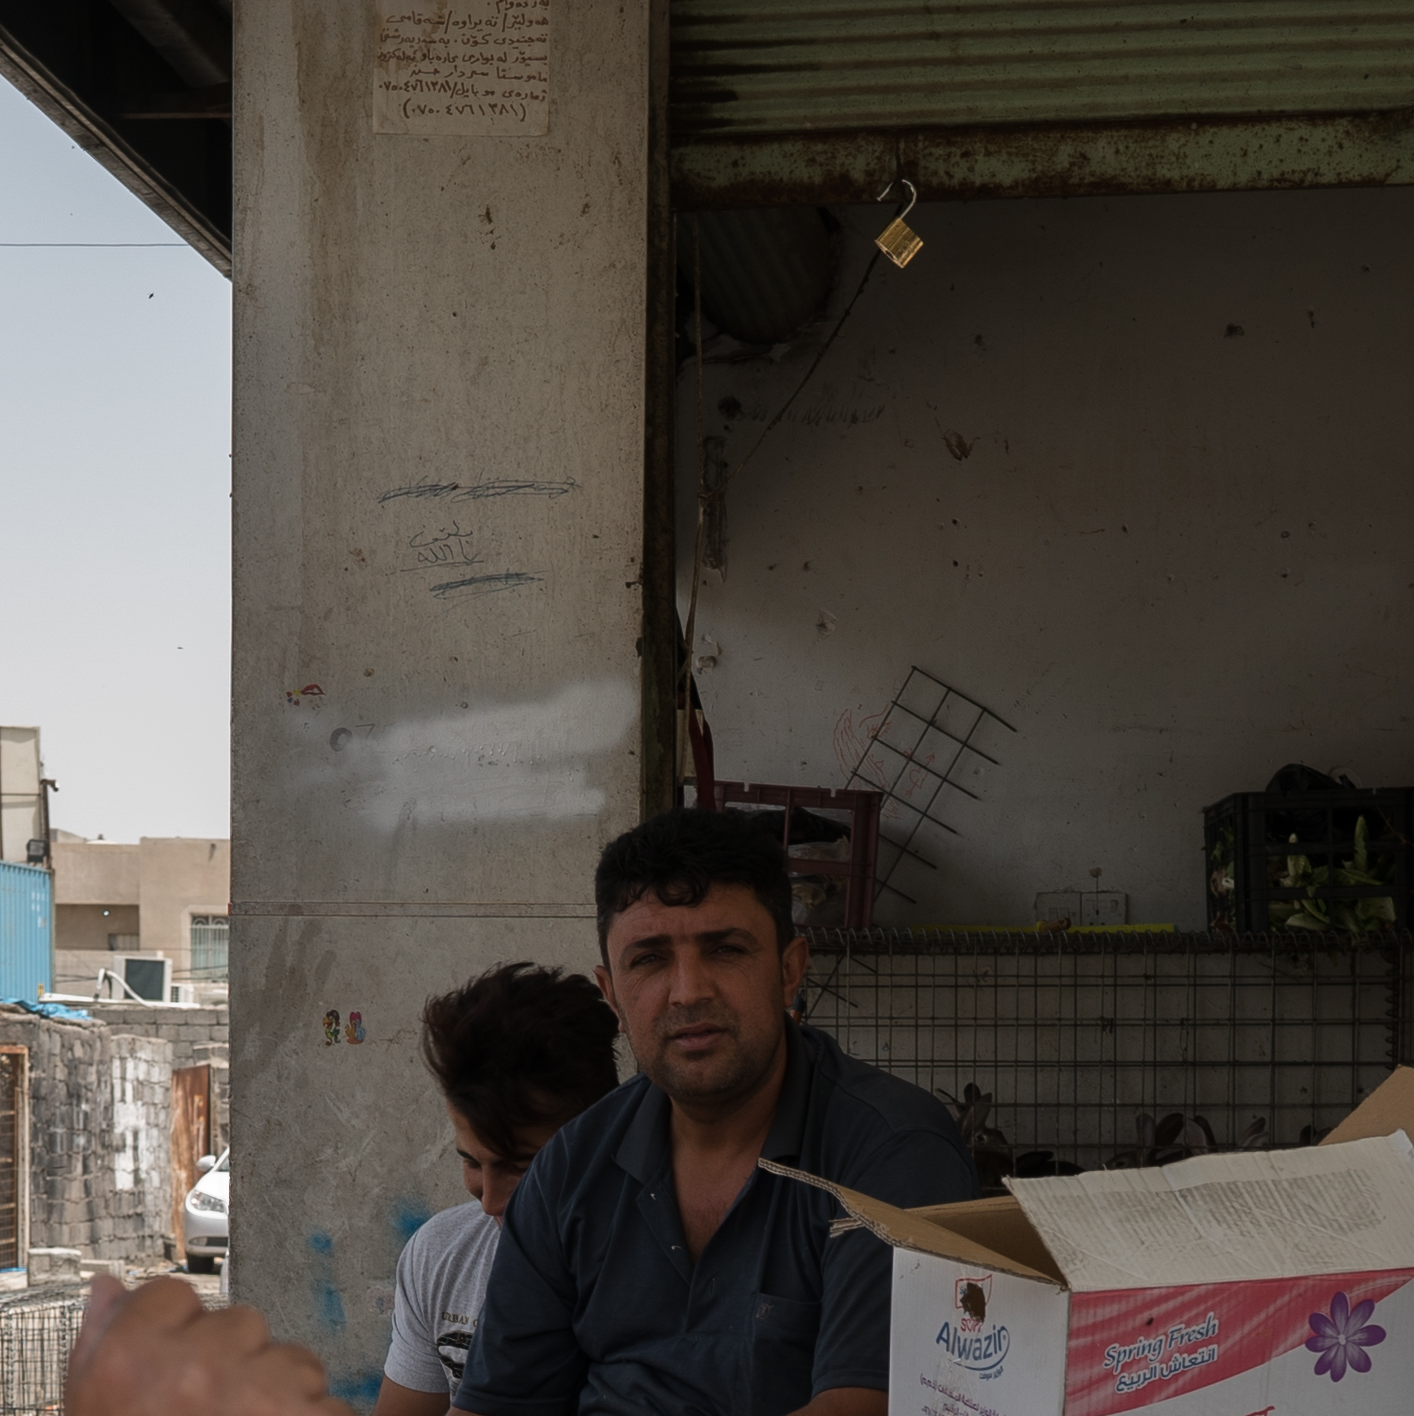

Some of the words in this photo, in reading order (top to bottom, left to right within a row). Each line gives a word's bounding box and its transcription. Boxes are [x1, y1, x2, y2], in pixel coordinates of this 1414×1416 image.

[936, 1321, 1011, 1361] Alwazir
[1103, 1334, 1164, 1374] Spring
[1166, 1311, 1219, 1351] Fresh
[1115, 1362, 1160, 1393] الربيع
[1159, 1346, 1218, 1380] انتعاش
